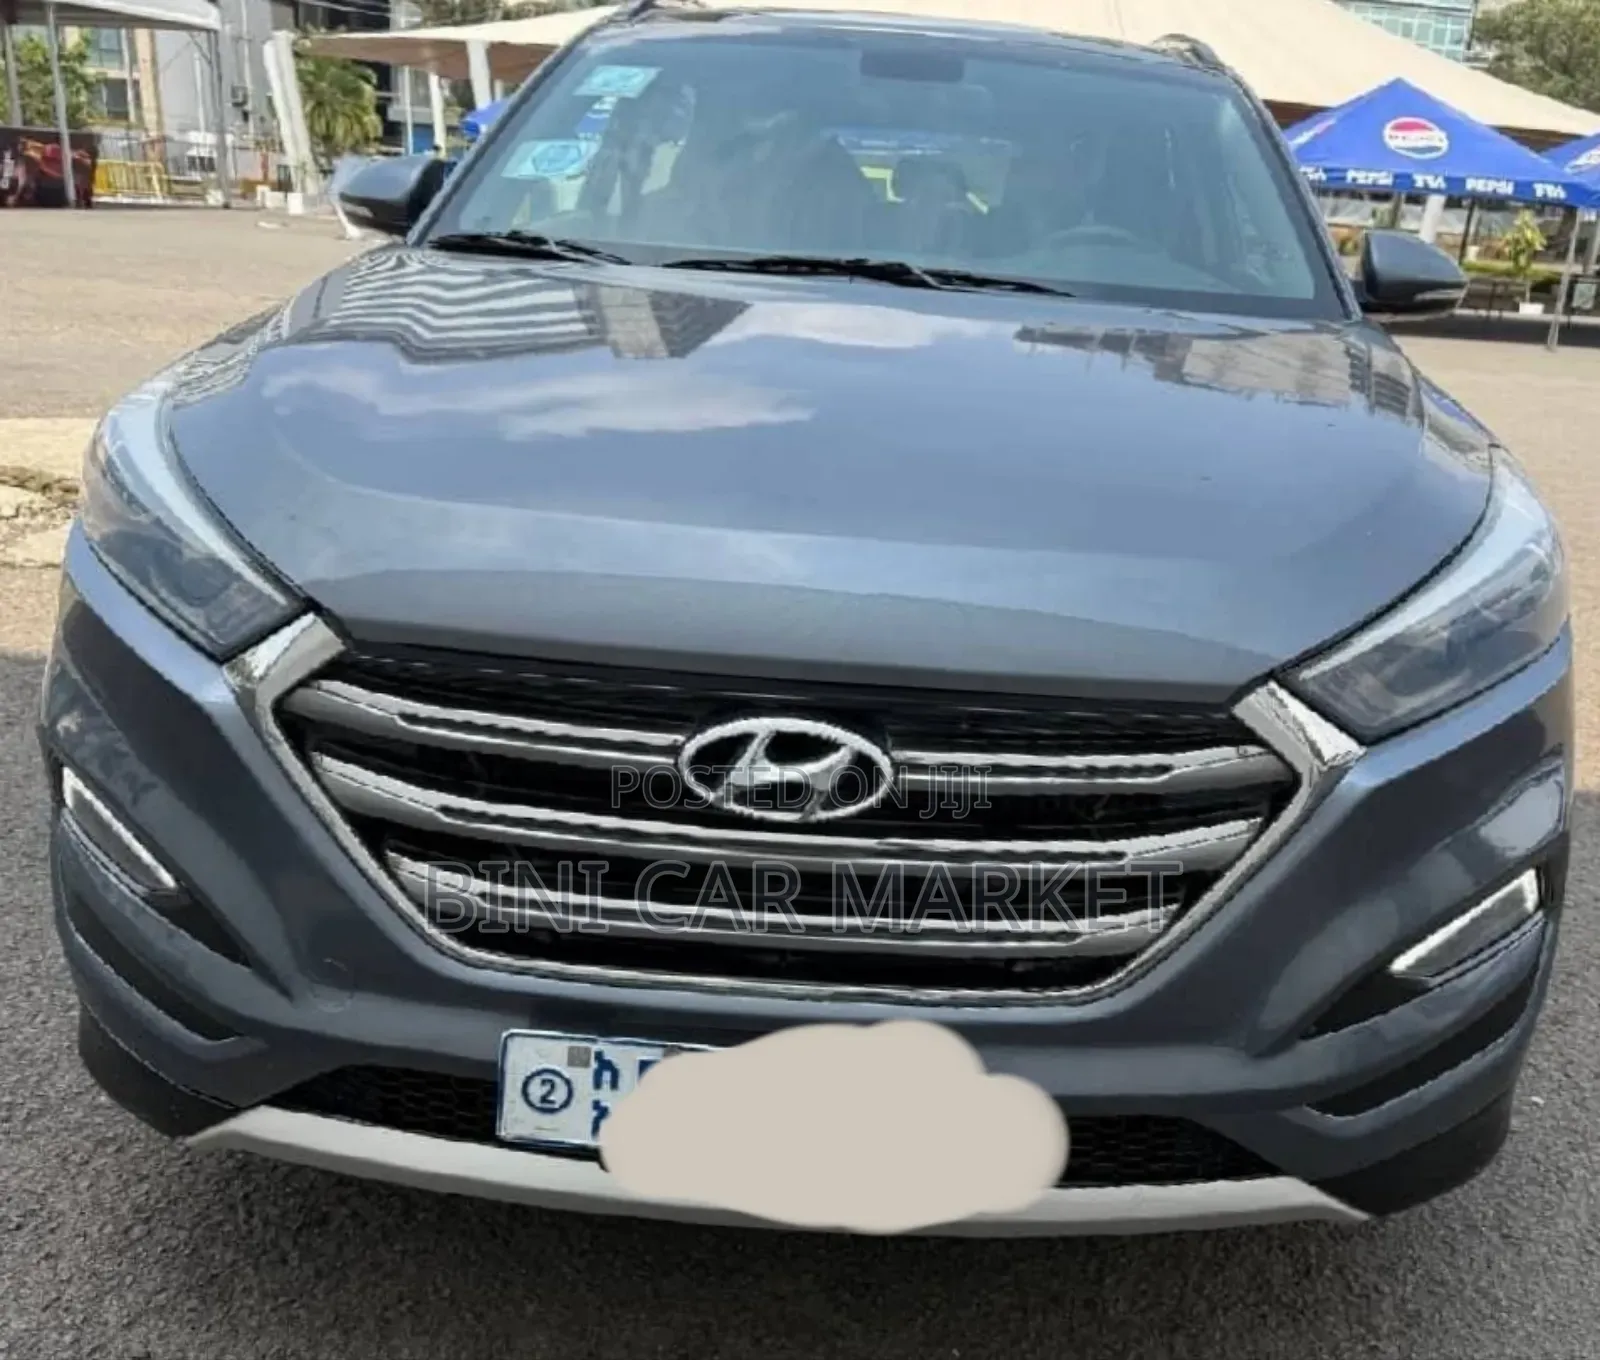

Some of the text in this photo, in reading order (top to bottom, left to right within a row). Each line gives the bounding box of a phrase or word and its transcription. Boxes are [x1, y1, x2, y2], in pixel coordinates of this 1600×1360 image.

[1346, 169, 1393, 186] PEPSI
[1465, 178, 1514, 195] PEPSI
[538, 1078, 557, 1104] 2
